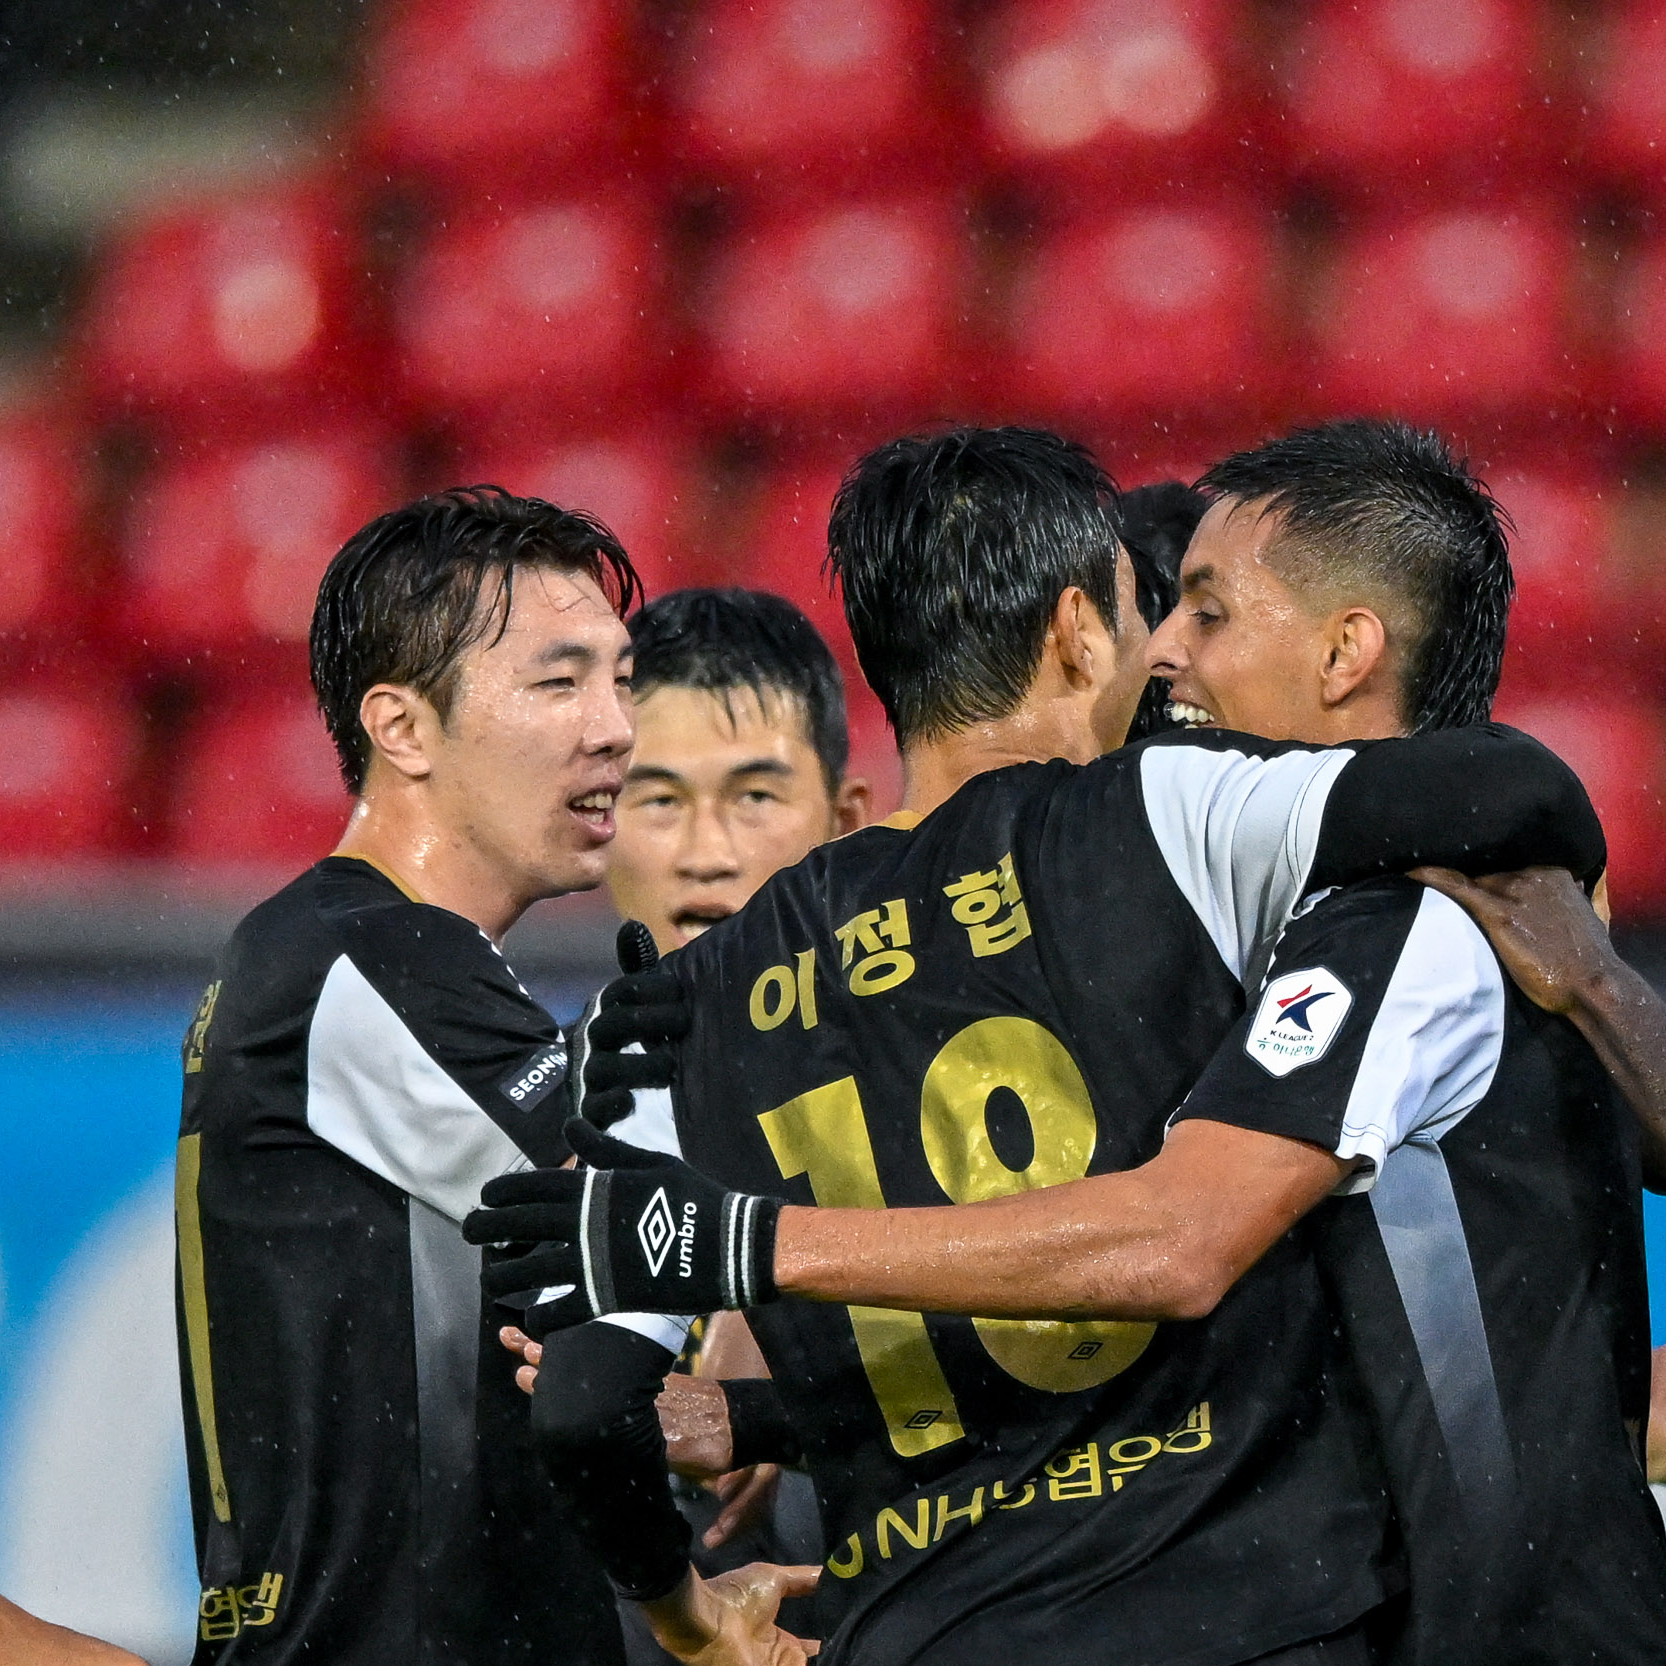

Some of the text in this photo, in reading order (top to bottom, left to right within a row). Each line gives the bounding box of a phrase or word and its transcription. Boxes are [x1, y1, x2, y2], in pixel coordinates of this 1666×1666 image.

[749, 851, 1033, 1031] 이정협
[677, 1201, 698, 1278] umbro
[757, 1016, 1158, 1459] 18
